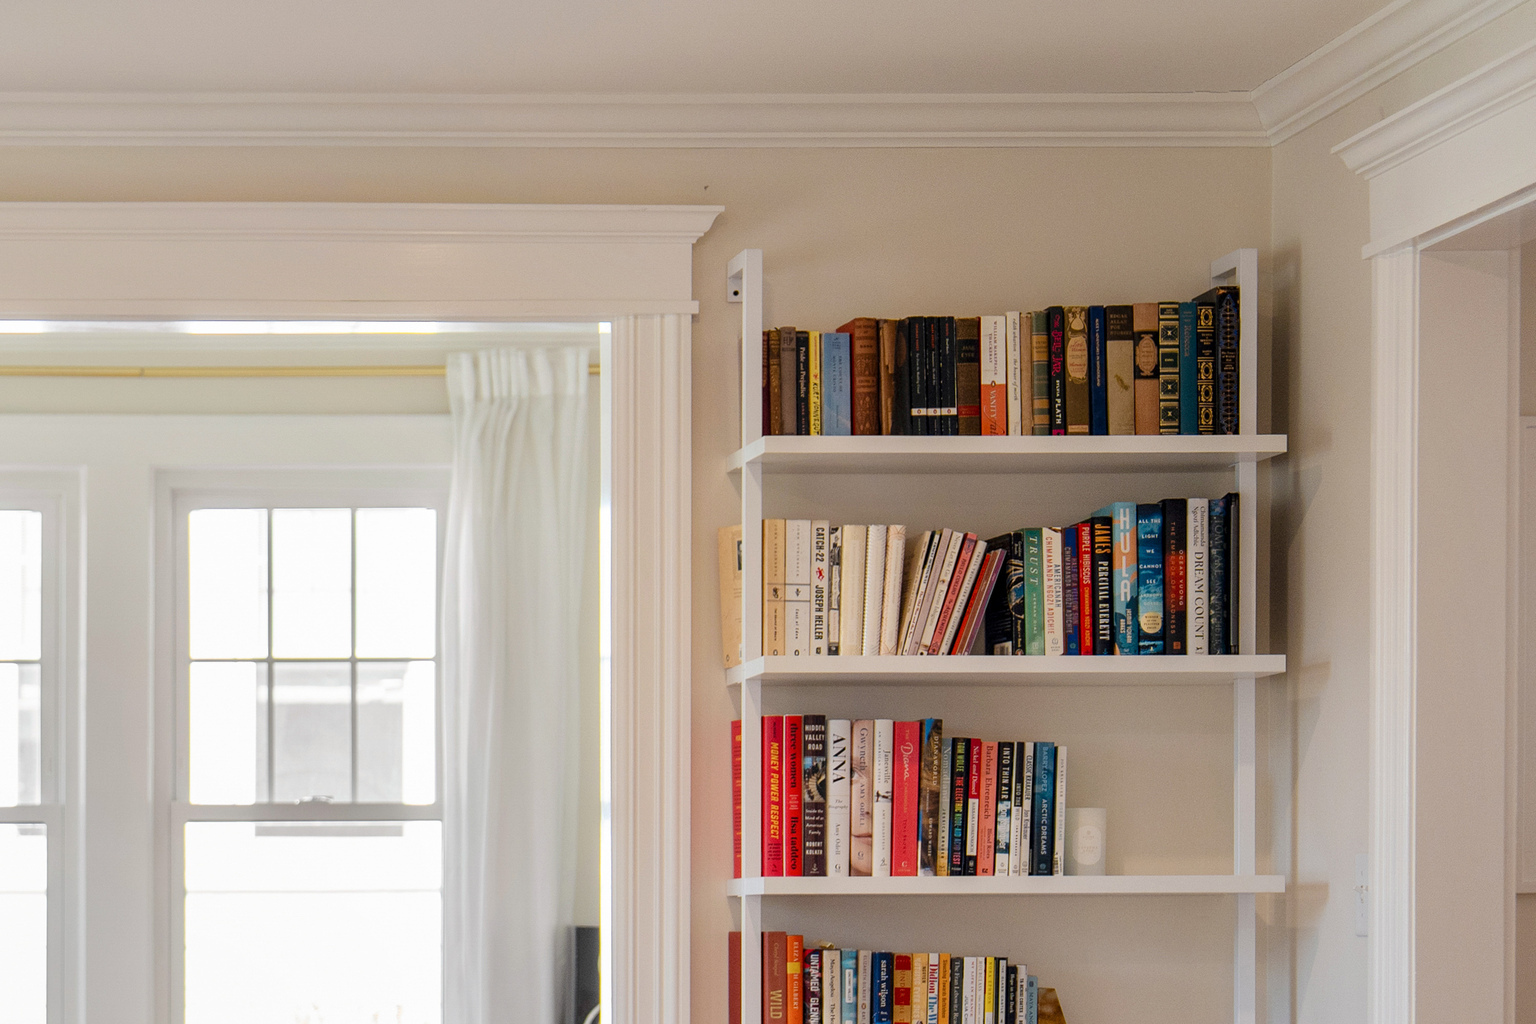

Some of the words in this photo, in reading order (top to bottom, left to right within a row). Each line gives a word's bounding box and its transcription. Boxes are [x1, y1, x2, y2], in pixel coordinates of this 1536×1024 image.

[799, 346, 807, 363] Pride
[1183, 324, 1191, 357] Rebecca
[1051, 354, 1063, 377] JAR
[799, 370, 807, 398] Prejudice
[812, 401, 820, 436] VONNEGUT
[815, 526, 825, 563] CATCH-22
[1081, 526, 1090, 552] PURPLE
[1094, 523, 1111, 555] JAMES
[1029, 536, 1039, 586] TRUST
[1045, 536, 1053, 582] CHIMAMANDA
[1082, 554, 1091, 585] HIBISCUS
[1119, 508, 1131, 602] HULA
[1053, 564, 1062, 608] AMERICANAH
[1097, 560, 1110, 601] PERCIVAL
[1194, 551, 1204, 594] DREAM
[814, 584, 824, 613] JOSEPH
[1046, 584, 1054, 606] NGOZI
[814, 614, 824, 641] HELLER
[1047, 607, 1055, 635] ADICHIE
[1098, 603, 1111, 641] EVERETT
[1194, 597, 1205, 640] COUNT
[789, 722, 798, 750] three
[770, 741, 779, 771] MONEY
[789, 752, 798, 788] women
[832, 733, 847, 784] ANNA
[882, 749, 891, 784] Janesville
[900, 741, 914, 781] Diana
[932, 735, 940, 787] DIANAWORLD
[984, 745, 994, 776] Barbara
[1002, 747, 1010, 765] INTO
[1041, 746, 1049, 769] BARRY
[770, 772, 779, 802] POWER
[970, 775, 978, 796] Dimed
[1001, 766, 1010, 784] THIN
[983, 777, 993, 820] Ehrenreich
[1001, 785, 1009, 800] AIR
[770, 804, 779, 840] RESPECT
[790, 816, 798, 835] lisa
[790, 836, 798, 870] taddeo
[1040, 825, 1048, 856] DREAMS
[810, 953, 820, 992] UNTAMED
[880, 959, 888, 982] sarah
[928, 963, 939, 994] Didion
[770, 989, 783, 1020] WILD
[879, 982, 888, 1008] wilson
[928, 995, 937, 1013] The
